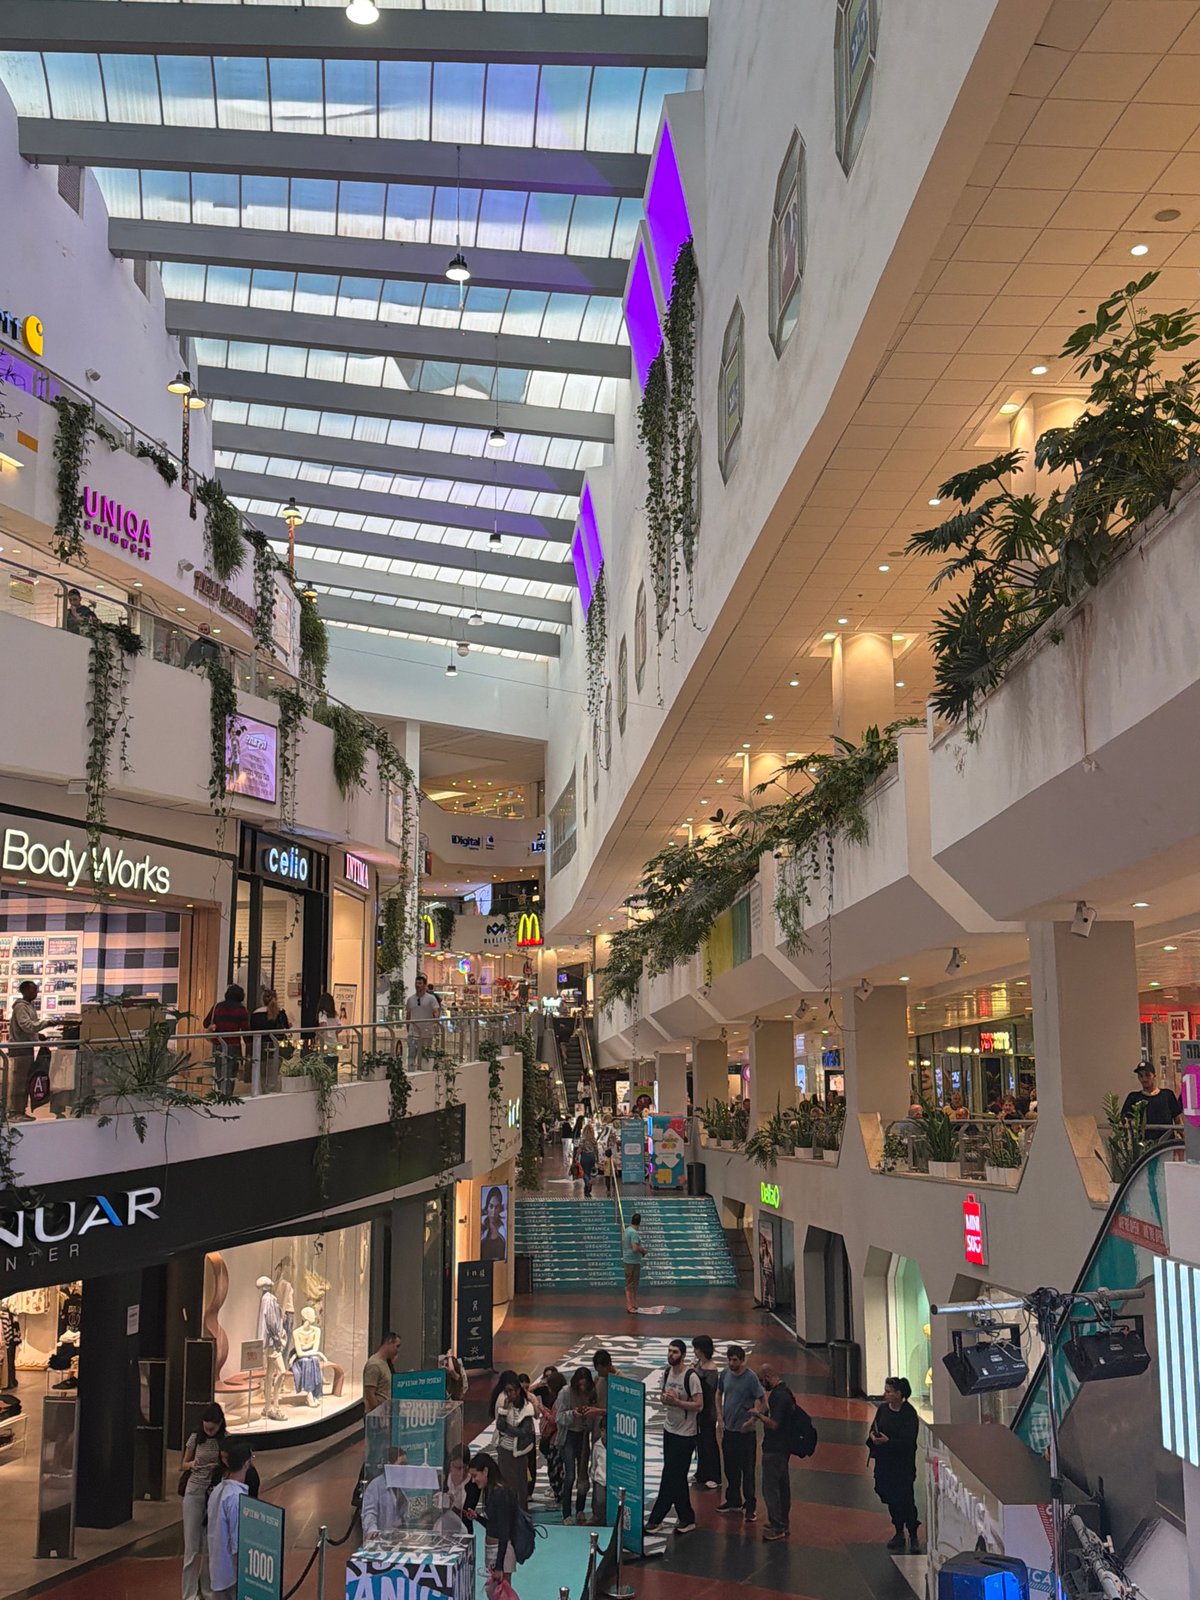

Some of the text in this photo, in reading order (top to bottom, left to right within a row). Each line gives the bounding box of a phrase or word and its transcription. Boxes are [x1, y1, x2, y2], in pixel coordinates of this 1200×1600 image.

[84, 486, 152, 548] UNIQA
[2, 828, 170, 894] Body Works
[269, 847, 308, 881] celio
[615, 1412, 638, 1439] 1000
[248, 1547, 274, 1584] 1000
